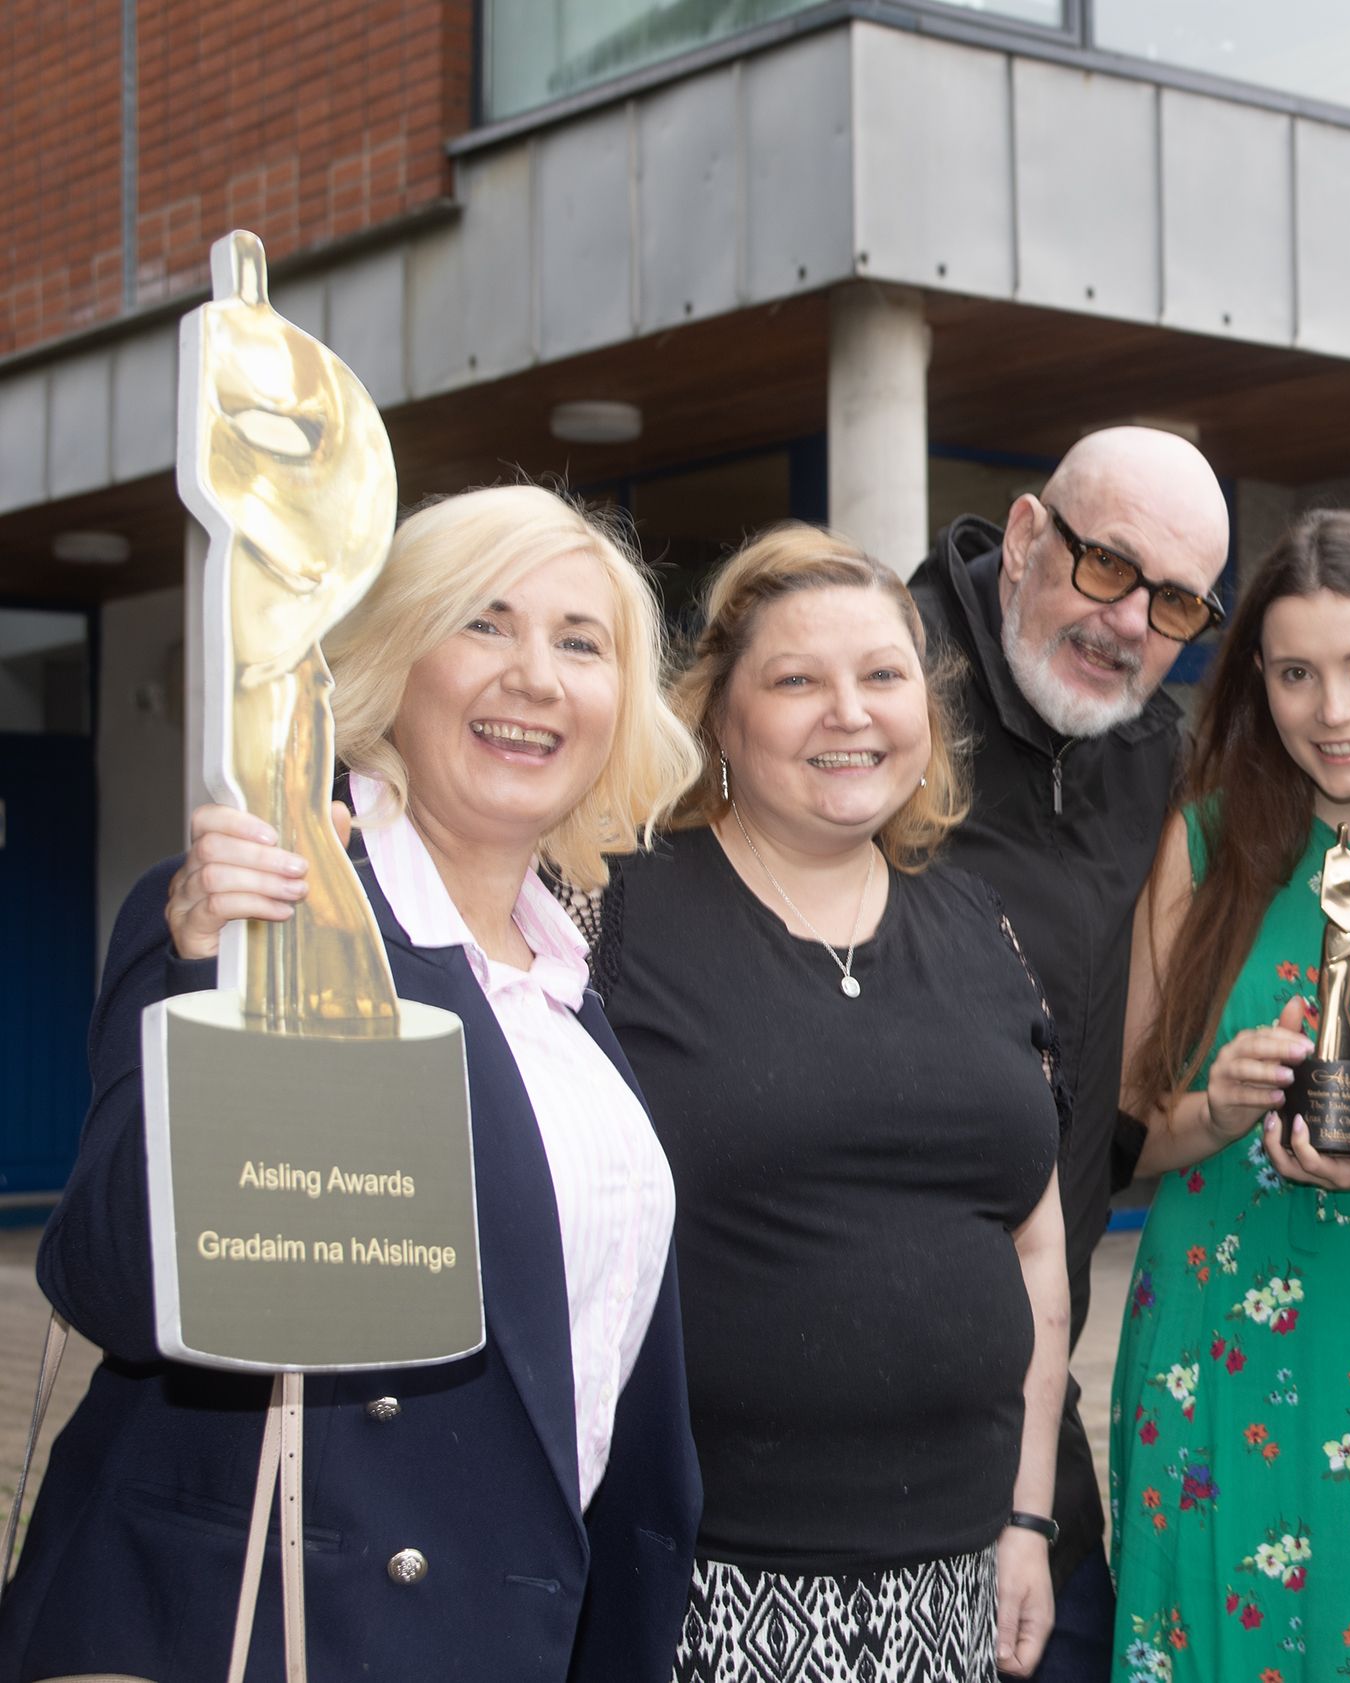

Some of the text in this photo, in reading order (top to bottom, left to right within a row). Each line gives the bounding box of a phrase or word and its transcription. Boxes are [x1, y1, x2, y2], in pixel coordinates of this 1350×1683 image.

[239, 1161, 416, 1198] Aisling Awards
[198, 1230, 457, 1273] Gradaim na hAislinge
